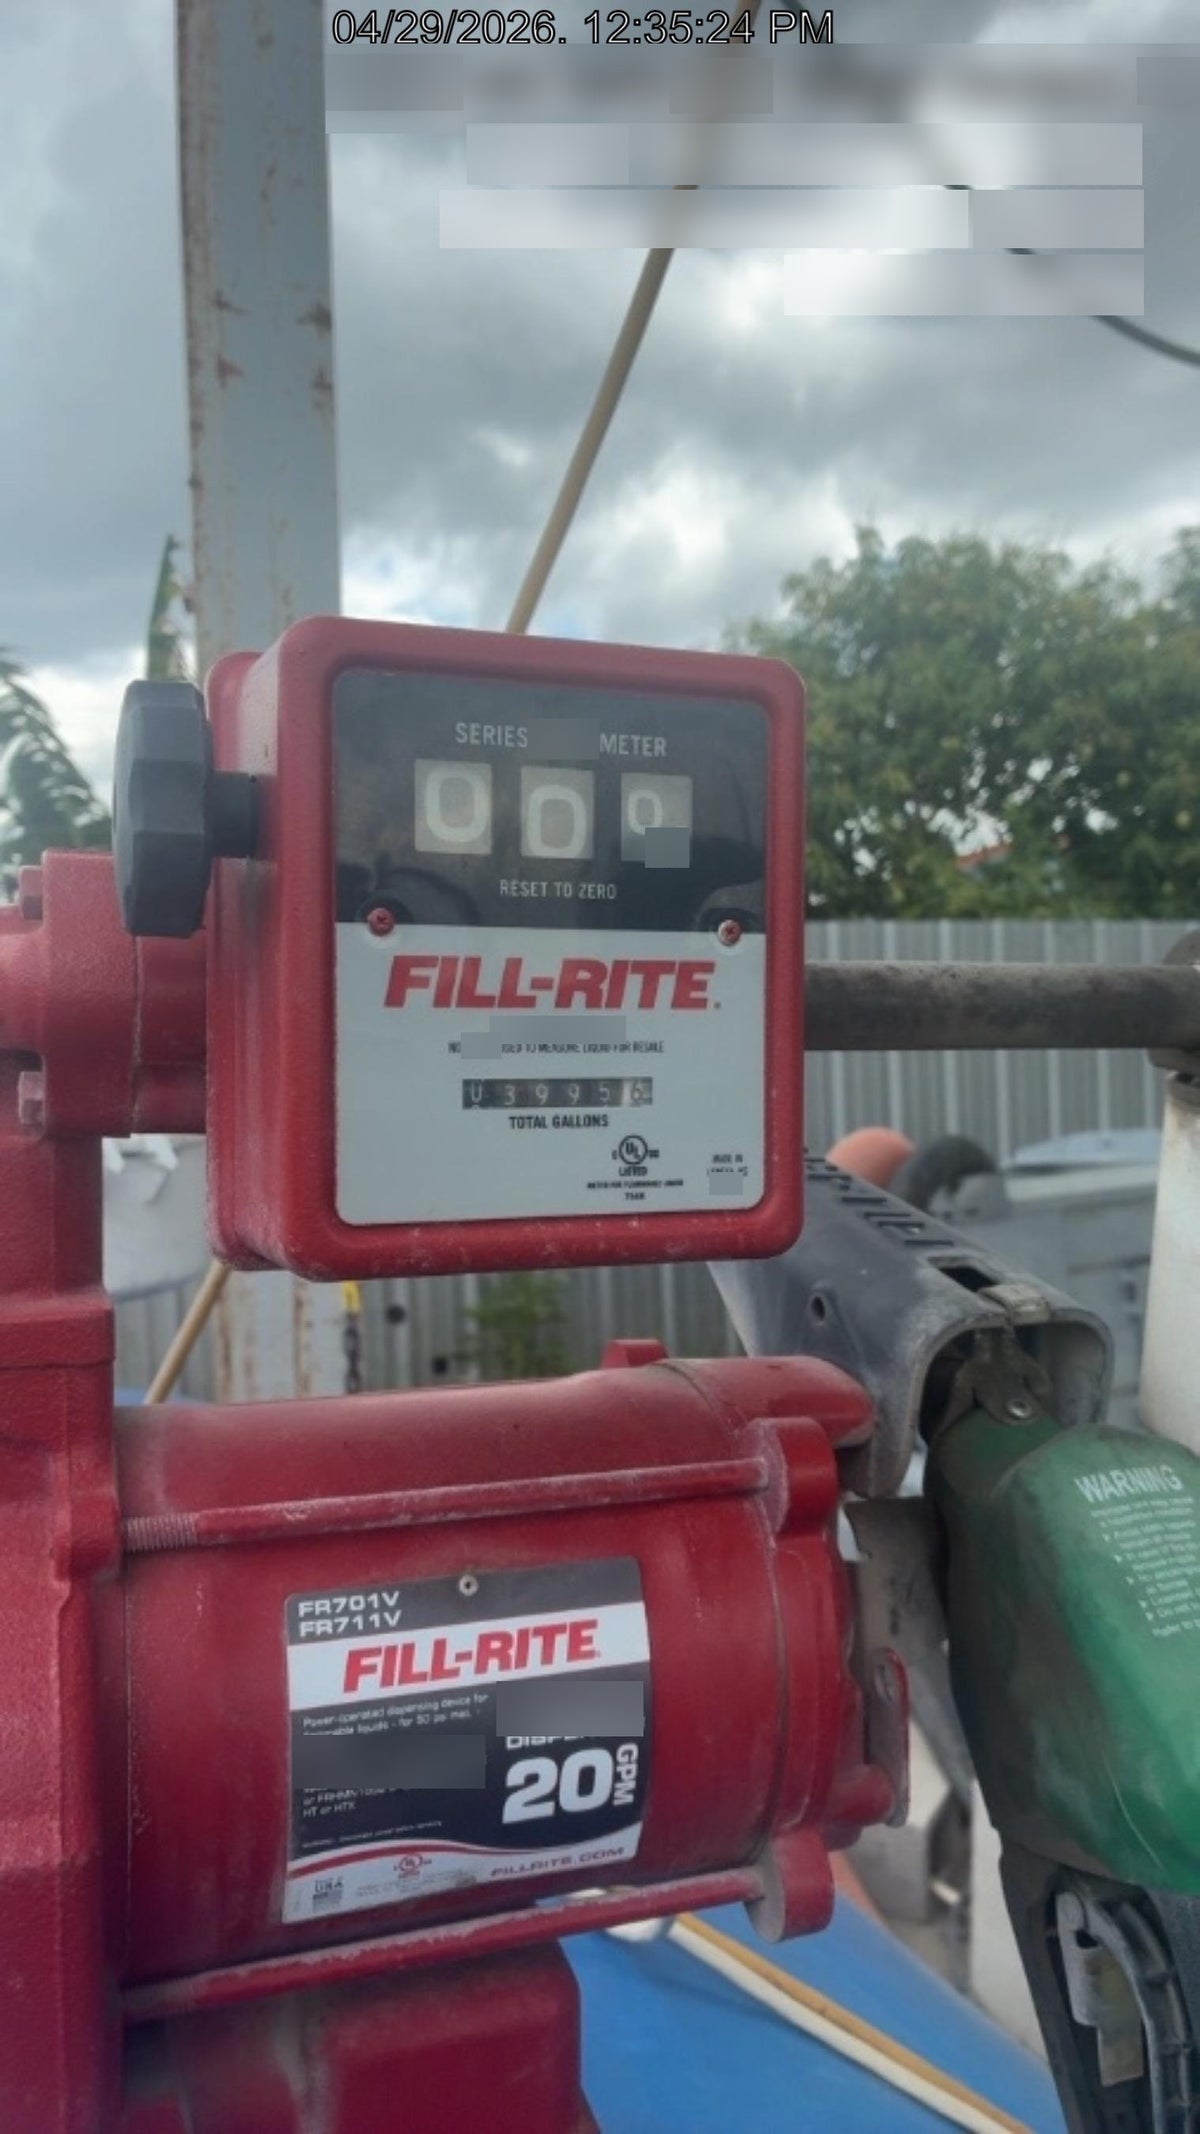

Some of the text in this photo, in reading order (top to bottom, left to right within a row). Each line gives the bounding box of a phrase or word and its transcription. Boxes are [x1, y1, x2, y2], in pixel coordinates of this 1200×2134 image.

[455, 722, 667, 757] SERIES METER
[424, 766, 492, 843] 0
[527, 784, 587, 859] 0
[500, 879, 617, 900] RESET TO ZERO
[383, 955, 716, 1010] FILL-RITE
[509, 1114, 609, 1130] TOTAL GALLONS
[1074, 1465, 1184, 1503] WARNING
[298, 1591, 400, 1618] FR701V
[299, 1610, 402, 1638] FR711V
[343, 1618, 599, 1694] FILL-RITE
[502, 1748, 614, 1825] 20
[612, 1742, 639, 1806] GPM
